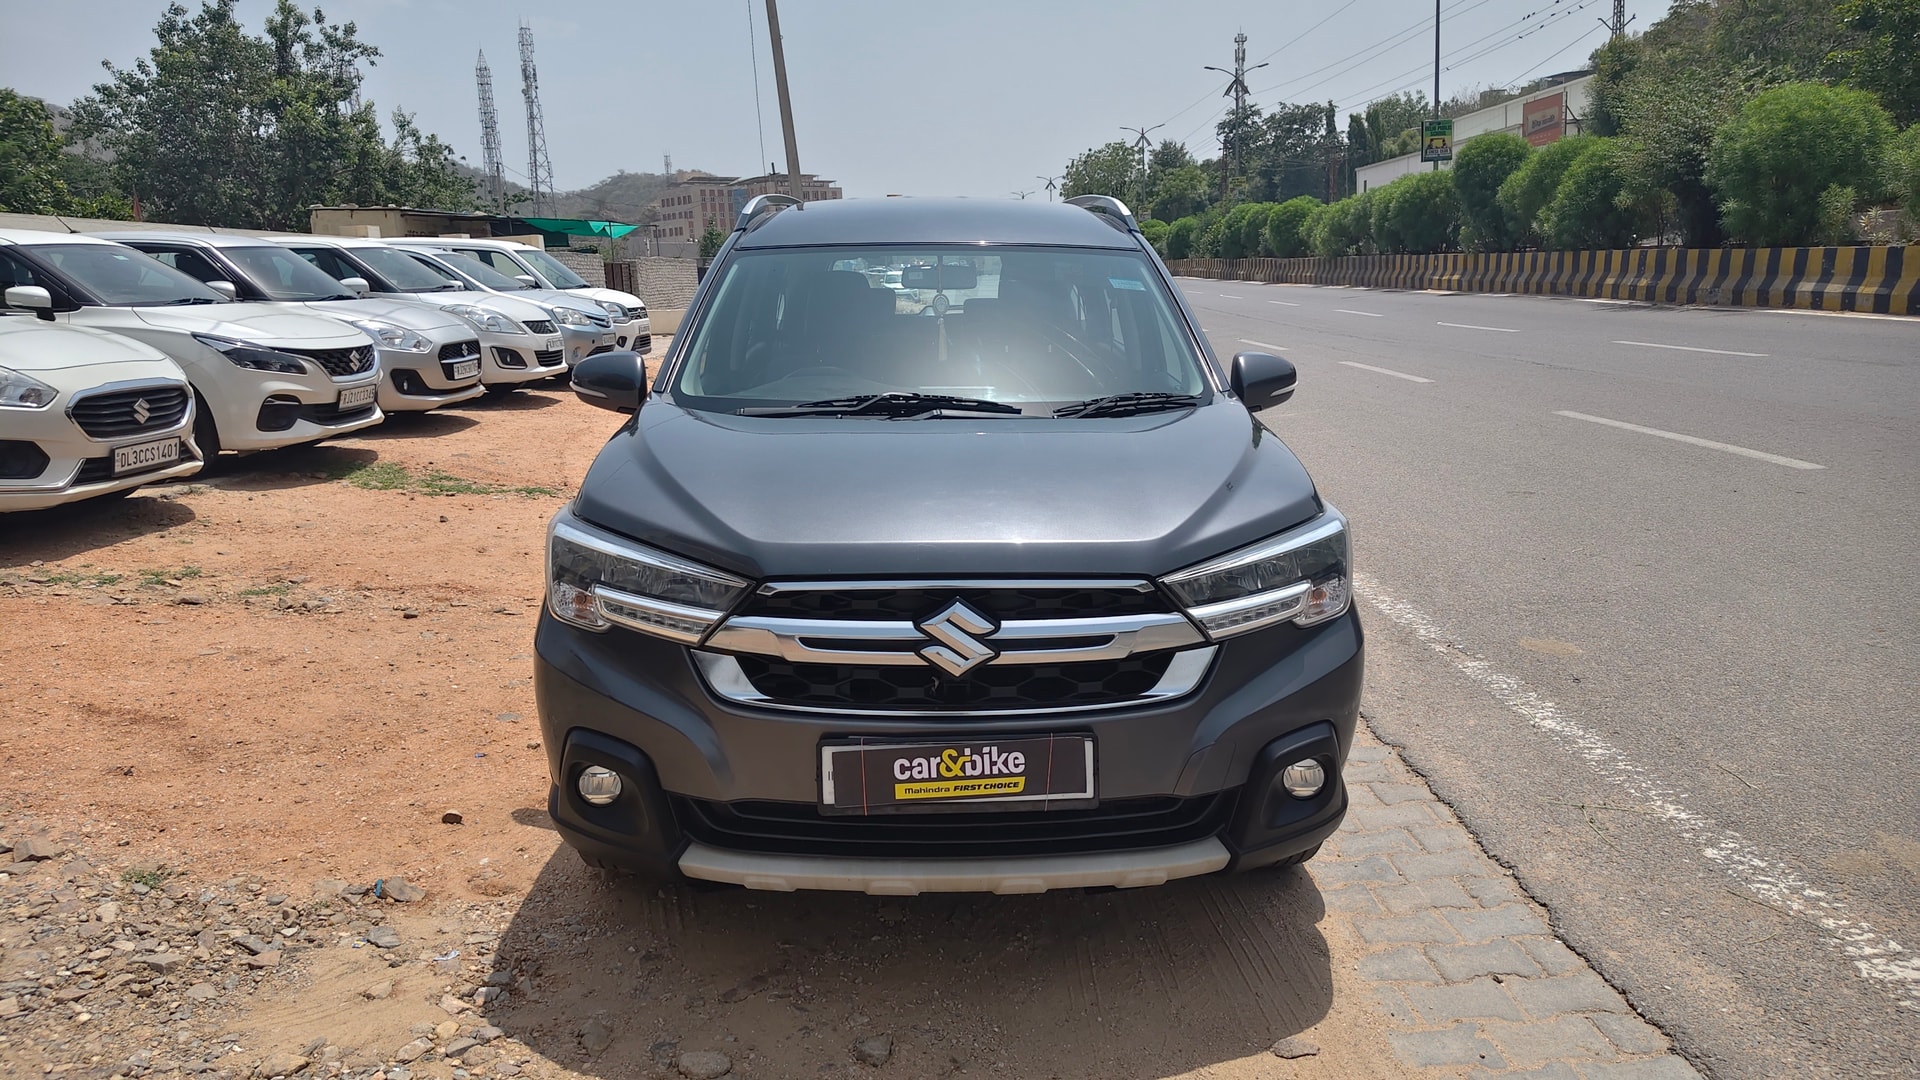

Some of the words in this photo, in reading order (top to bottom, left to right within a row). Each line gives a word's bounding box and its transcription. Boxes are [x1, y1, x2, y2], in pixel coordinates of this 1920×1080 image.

[121, 442, 178, 468] DL3CCS1401
[893, 746, 1026, 780] car&bike
[904, 785, 950, 795] Mahindra
[953, 783, 983, 792] FIRST
[984, 781, 1020, 790] CHOICE
